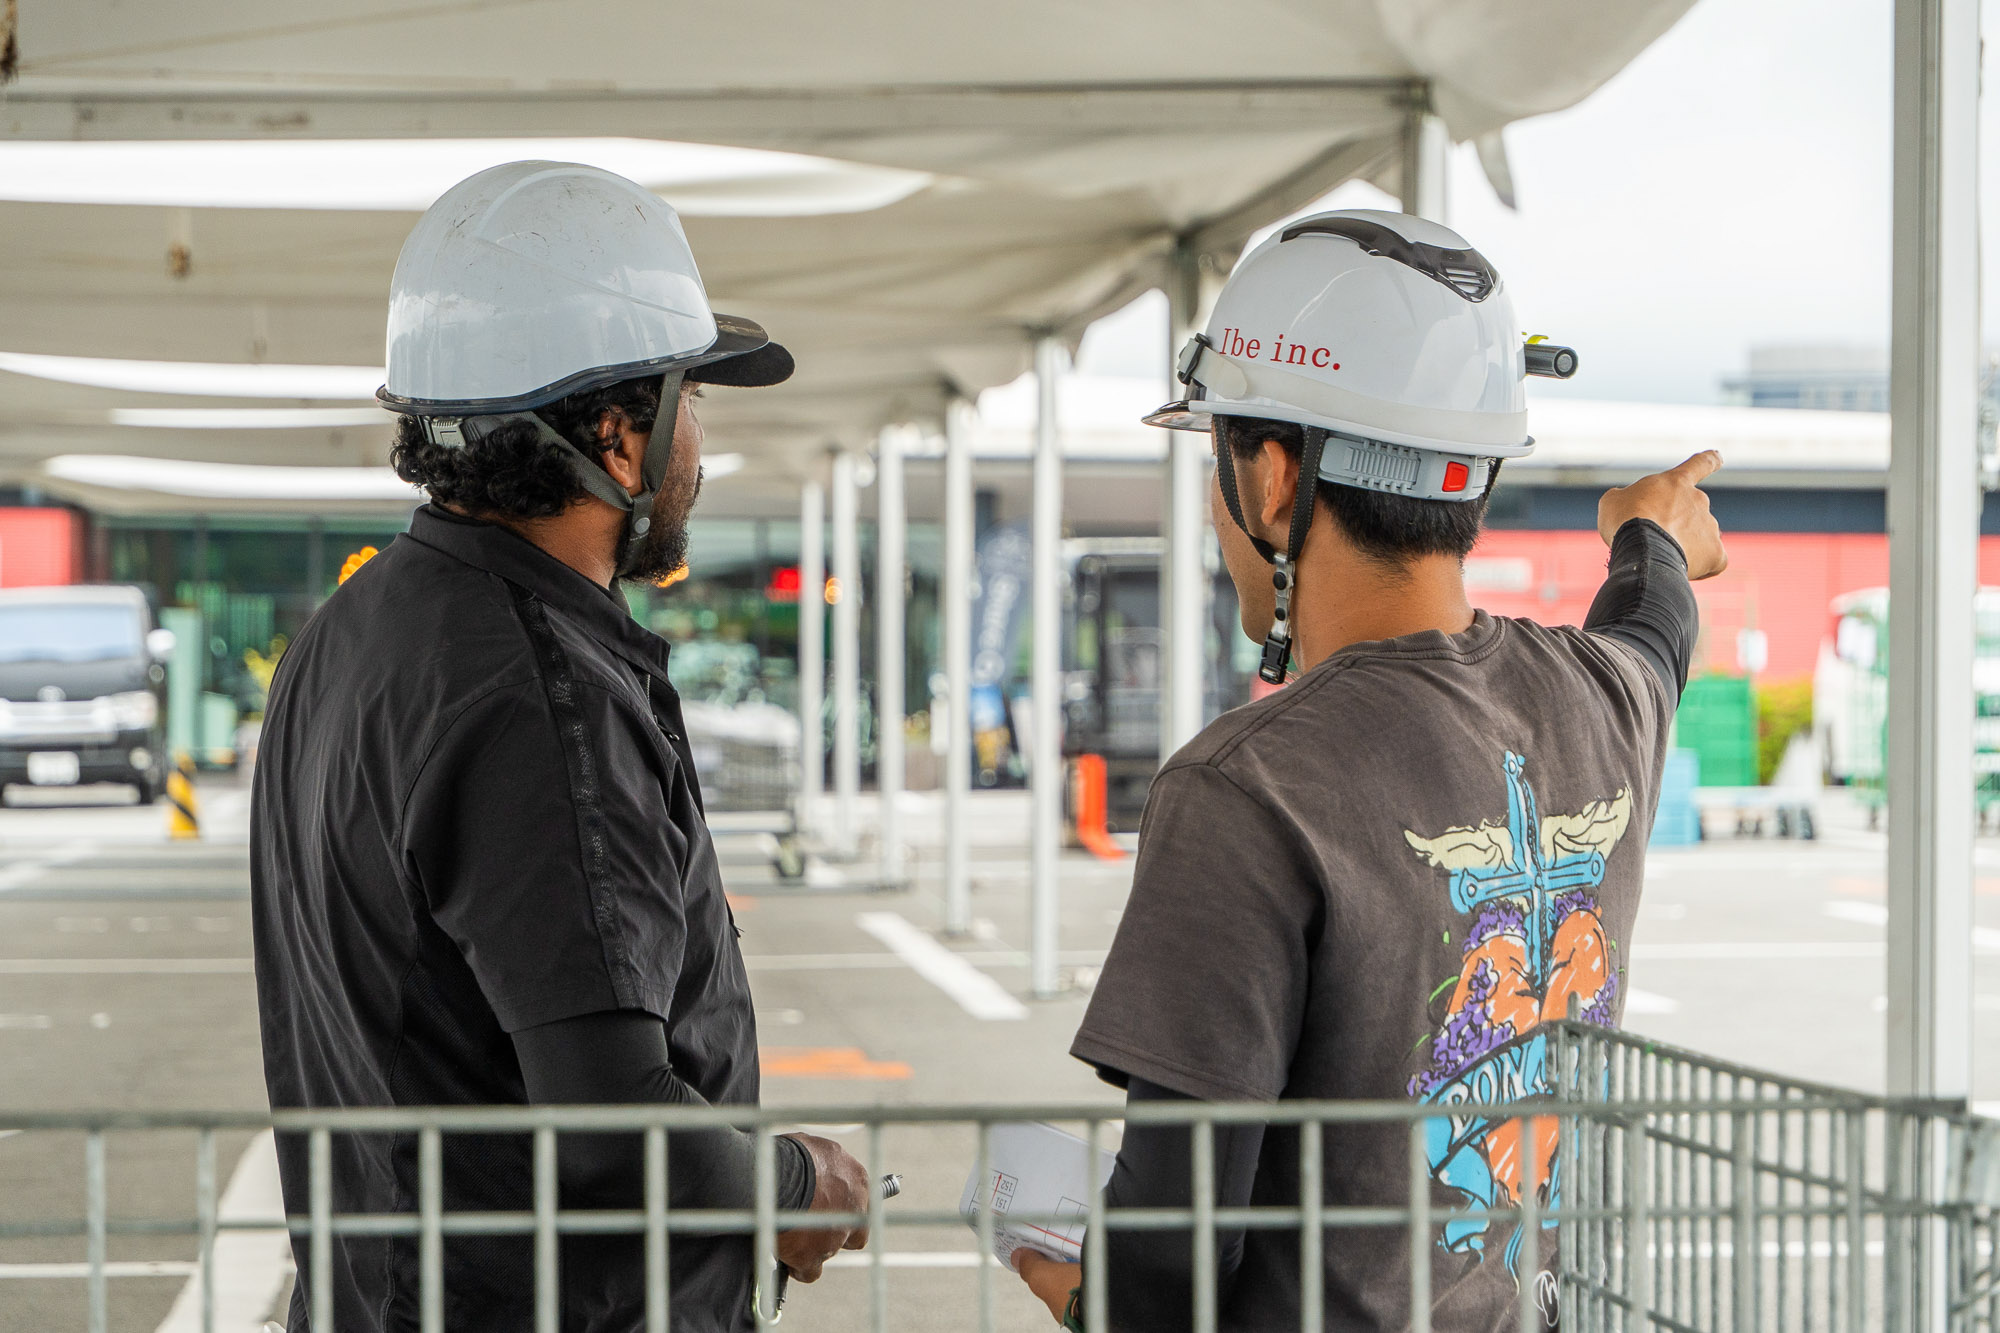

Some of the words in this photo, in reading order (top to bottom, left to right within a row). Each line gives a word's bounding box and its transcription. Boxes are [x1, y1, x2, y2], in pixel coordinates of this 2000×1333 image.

[1219, 328, 1260, 359] Ibe
[1270, 334, 1341, 371] inc.
[1000, 1179, 1014, 1192] 152
[995, 1197, 1008, 1210] 151
